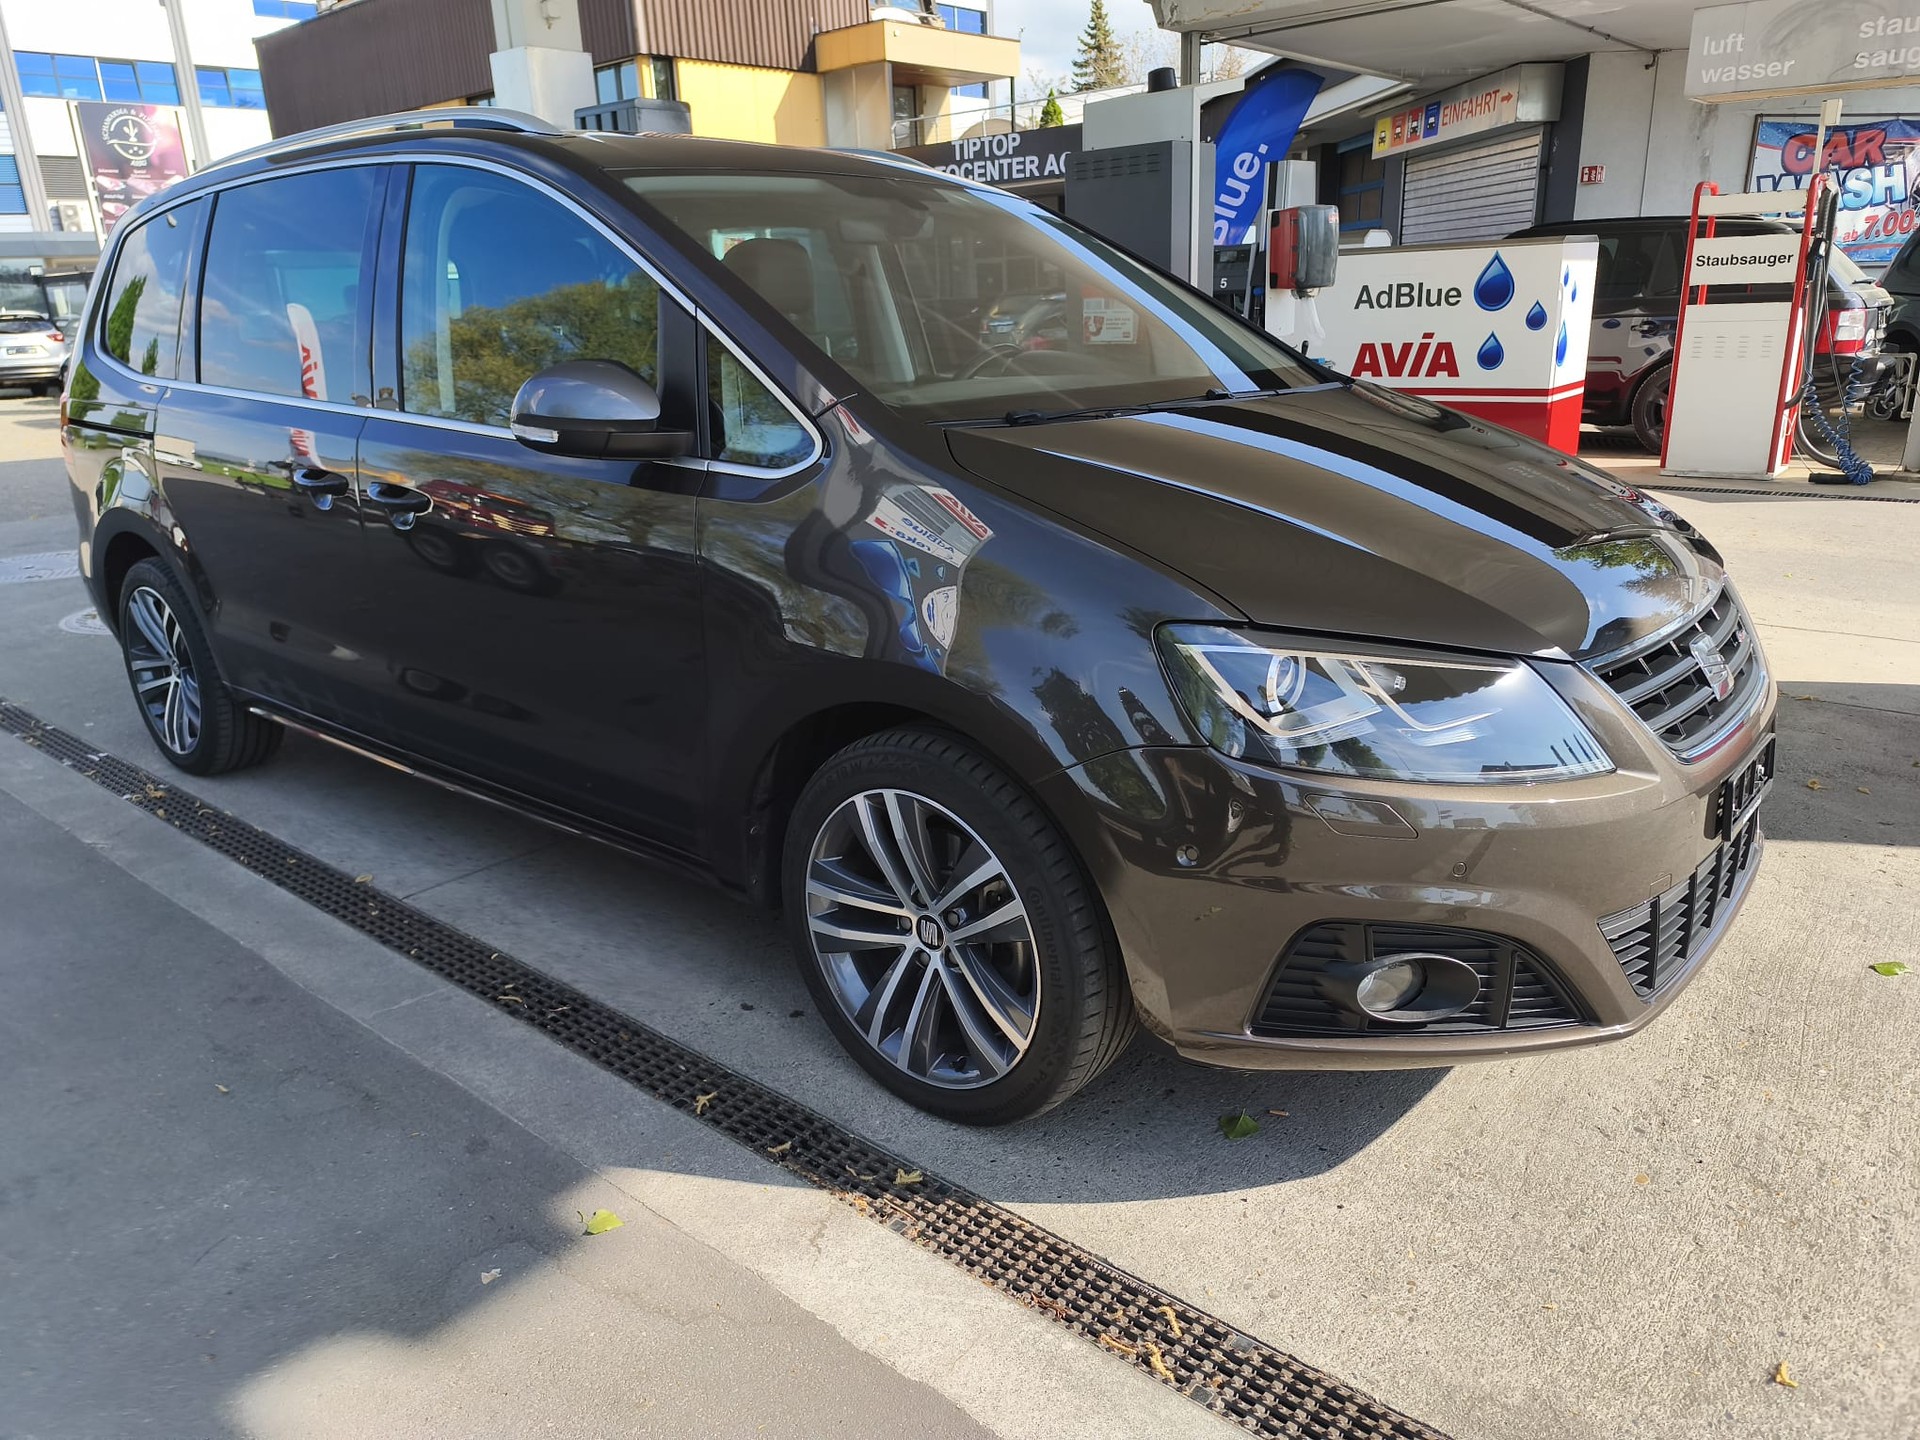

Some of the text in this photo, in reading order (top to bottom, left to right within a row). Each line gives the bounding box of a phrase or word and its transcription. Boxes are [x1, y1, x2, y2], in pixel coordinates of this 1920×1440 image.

[1703, 33, 1745, 56] luft
[1701, 59, 1795, 84] wasser
[1441, 89, 1500, 127] EINFAHRT
[952, 133, 1021, 160] TIPTOP
[1782, 128, 1887, 174] CAR
[1756, 162, 1908, 217] WSH
[1843, 230, 1858, 243] ab
[1696, 254, 1794, 267] Staubsauger
[1219, 278, 1228, 289] 5
[1354, 282, 1462, 310] AdBlue
